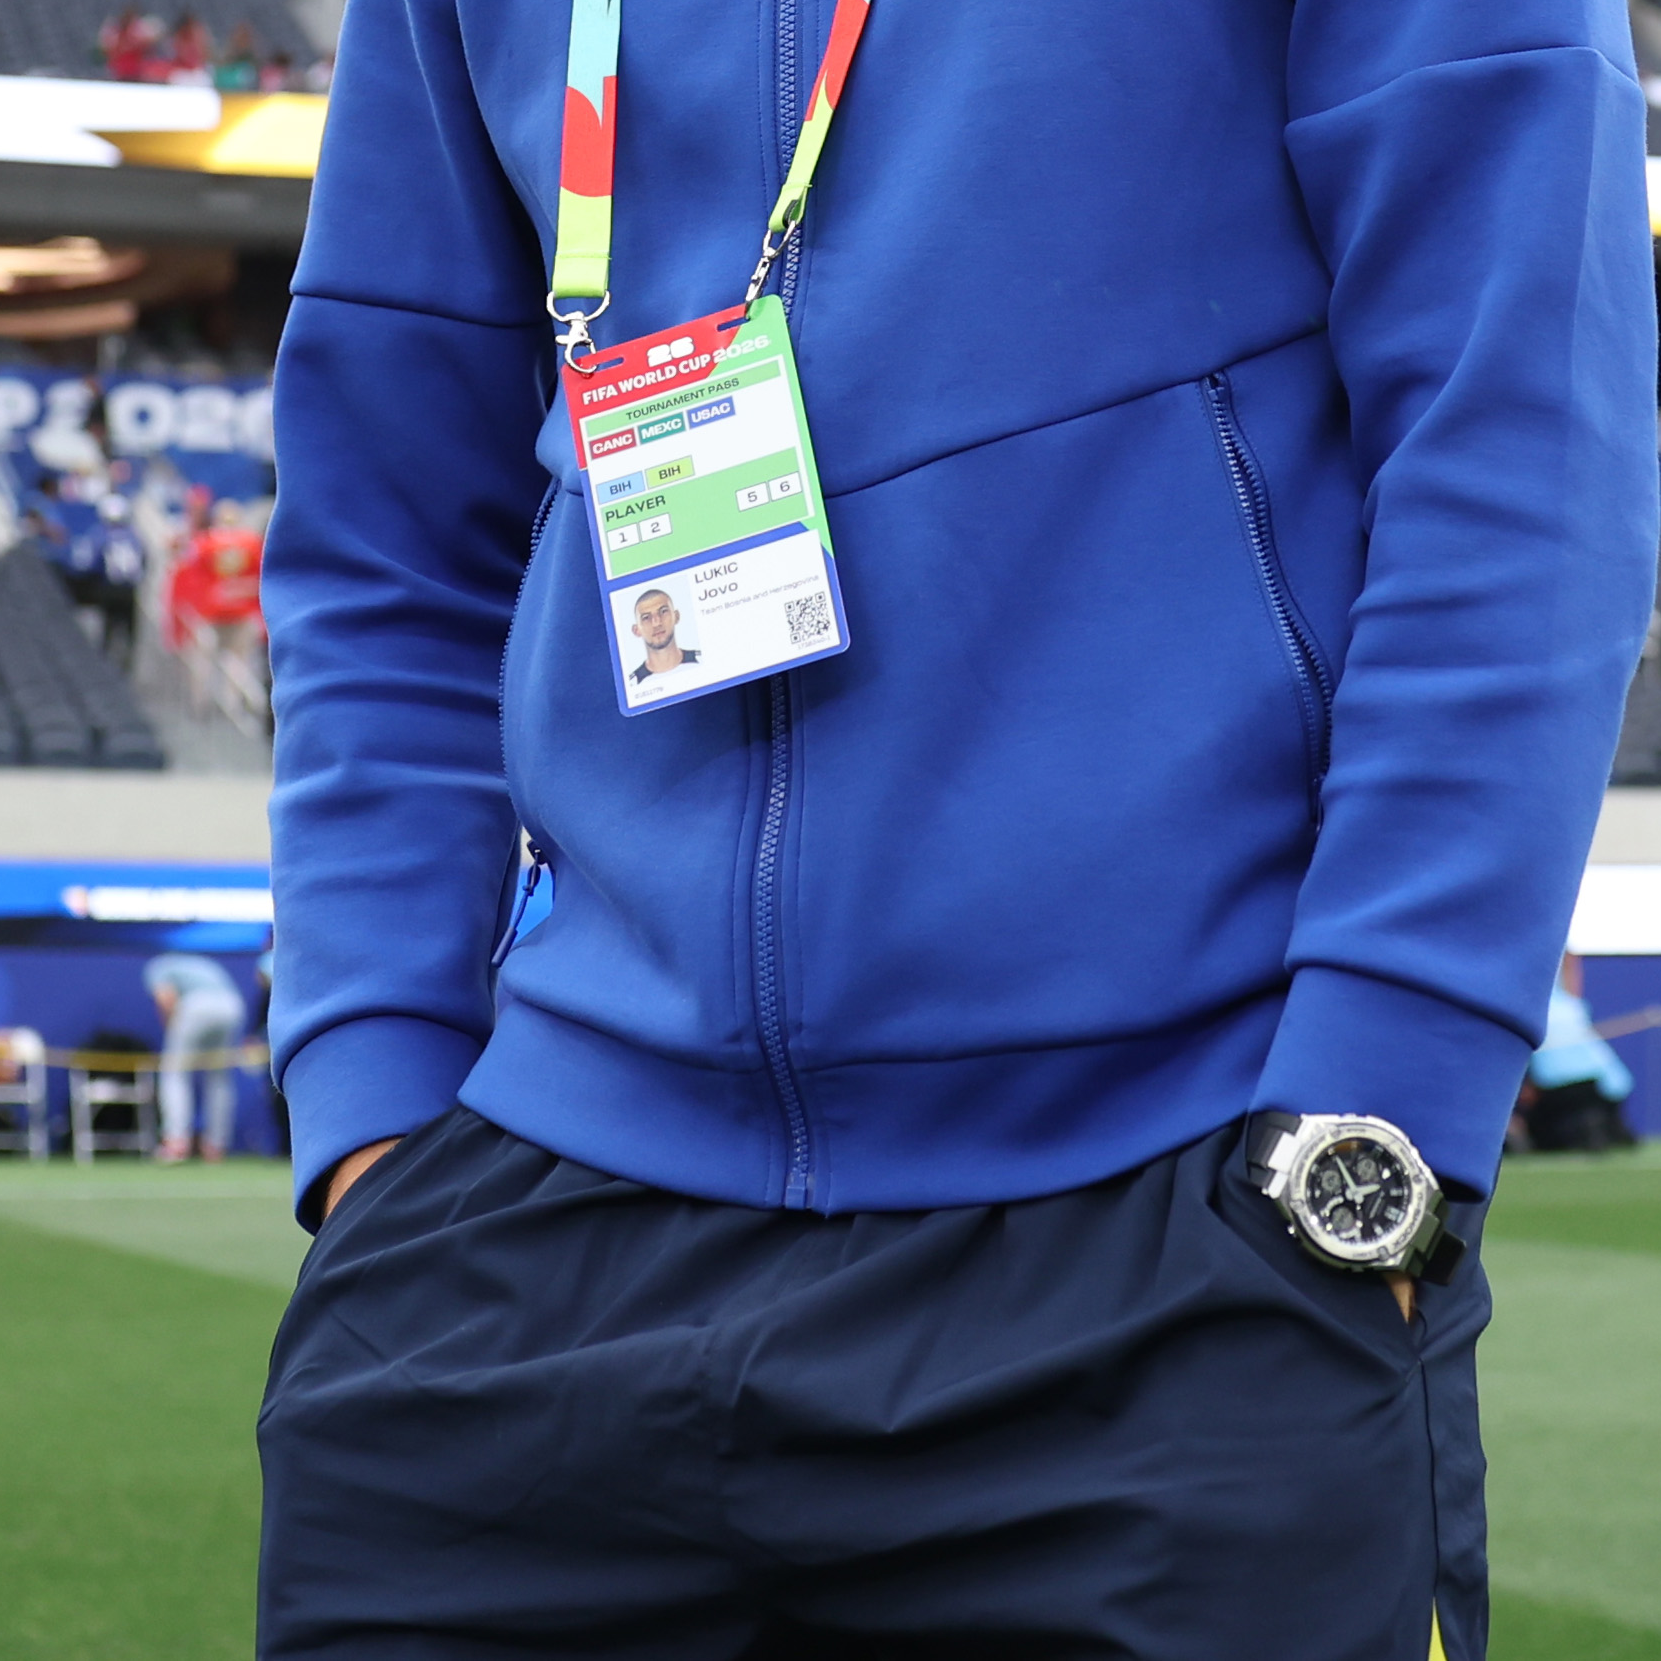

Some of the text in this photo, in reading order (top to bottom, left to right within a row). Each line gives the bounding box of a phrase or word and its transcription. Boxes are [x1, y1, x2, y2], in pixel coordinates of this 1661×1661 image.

[646, 336, 696, 368] 26
[582, 334, 771, 406] FIFA WORLD CUP 2026
[625, 378, 740, 421] TOURNAMENT PASS
[690, 401, 732, 424] USAC
[640, 417, 684, 441] MEXC
[592, 432, 634, 455] CANC
[658, 464, 682, 481] BIH
[609, 480, 633, 496] BIH
[747, 490, 759, 503] 5
[779, 480, 791, 493] 6
[605, 494, 667, 523] PLAYER
[619, 532, 628, 544] 1
[650, 521, 661, 534] 2
[694, 561, 739, 585] LUKIC
[698, 582, 739, 602] Jovo
